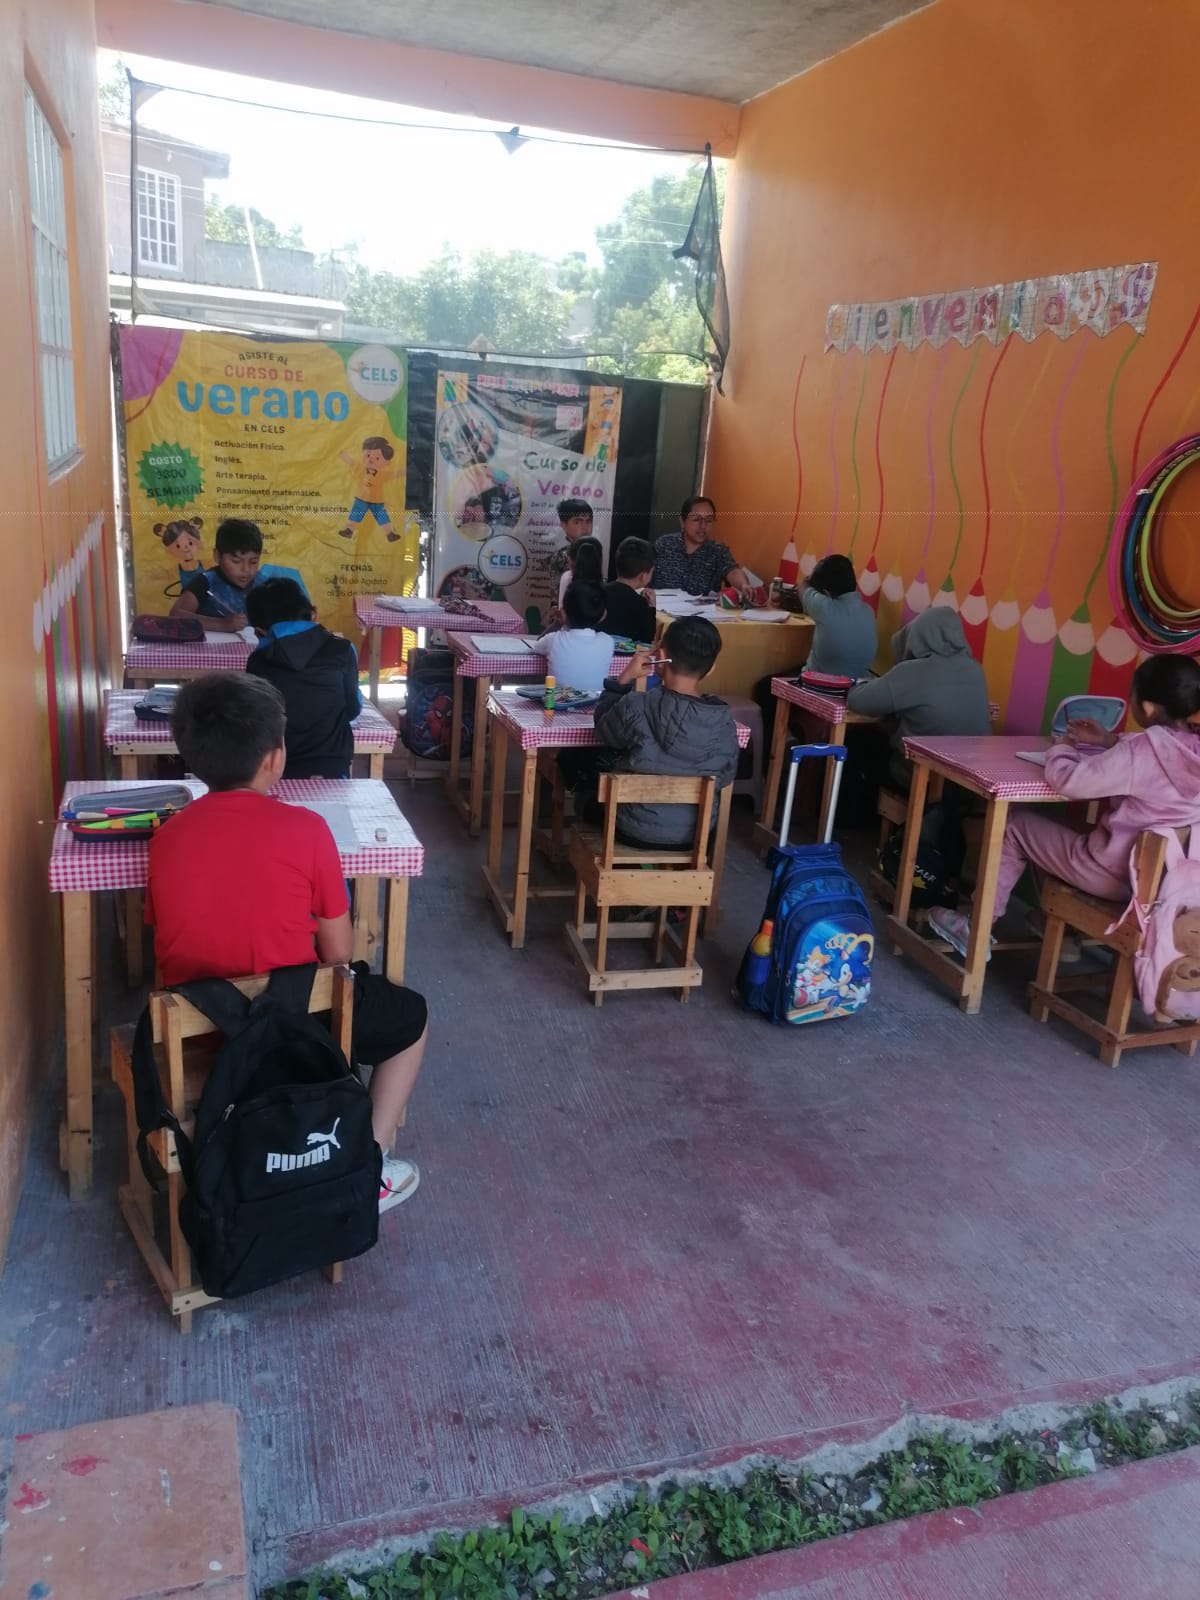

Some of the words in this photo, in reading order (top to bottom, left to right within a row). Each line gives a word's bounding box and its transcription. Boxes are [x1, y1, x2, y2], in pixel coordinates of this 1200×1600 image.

[238, 351, 275, 362] ASISTE
[277, 355, 289, 366] AL
[224, 364, 279, 381] CURSO
[284, 368, 305, 382] DE
[360, 367, 398, 382] CELS
[177, 380, 351, 423] verano
[244, 423, 258, 433] EN
[261, 424, 286, 434] CELS
[148, 456, 183, 466] COSTO
[523, 451, 579, 471] Curso
[585, 456, 607, 473] de
[147, 484, 206, 499] SEMANAL
[537, 479, 605, 499] Verano
[340, 564, 373, 572] FECHAS
[490, 554, 522, 567] CELS
[266, 1143, 331, 1173] PUMA
